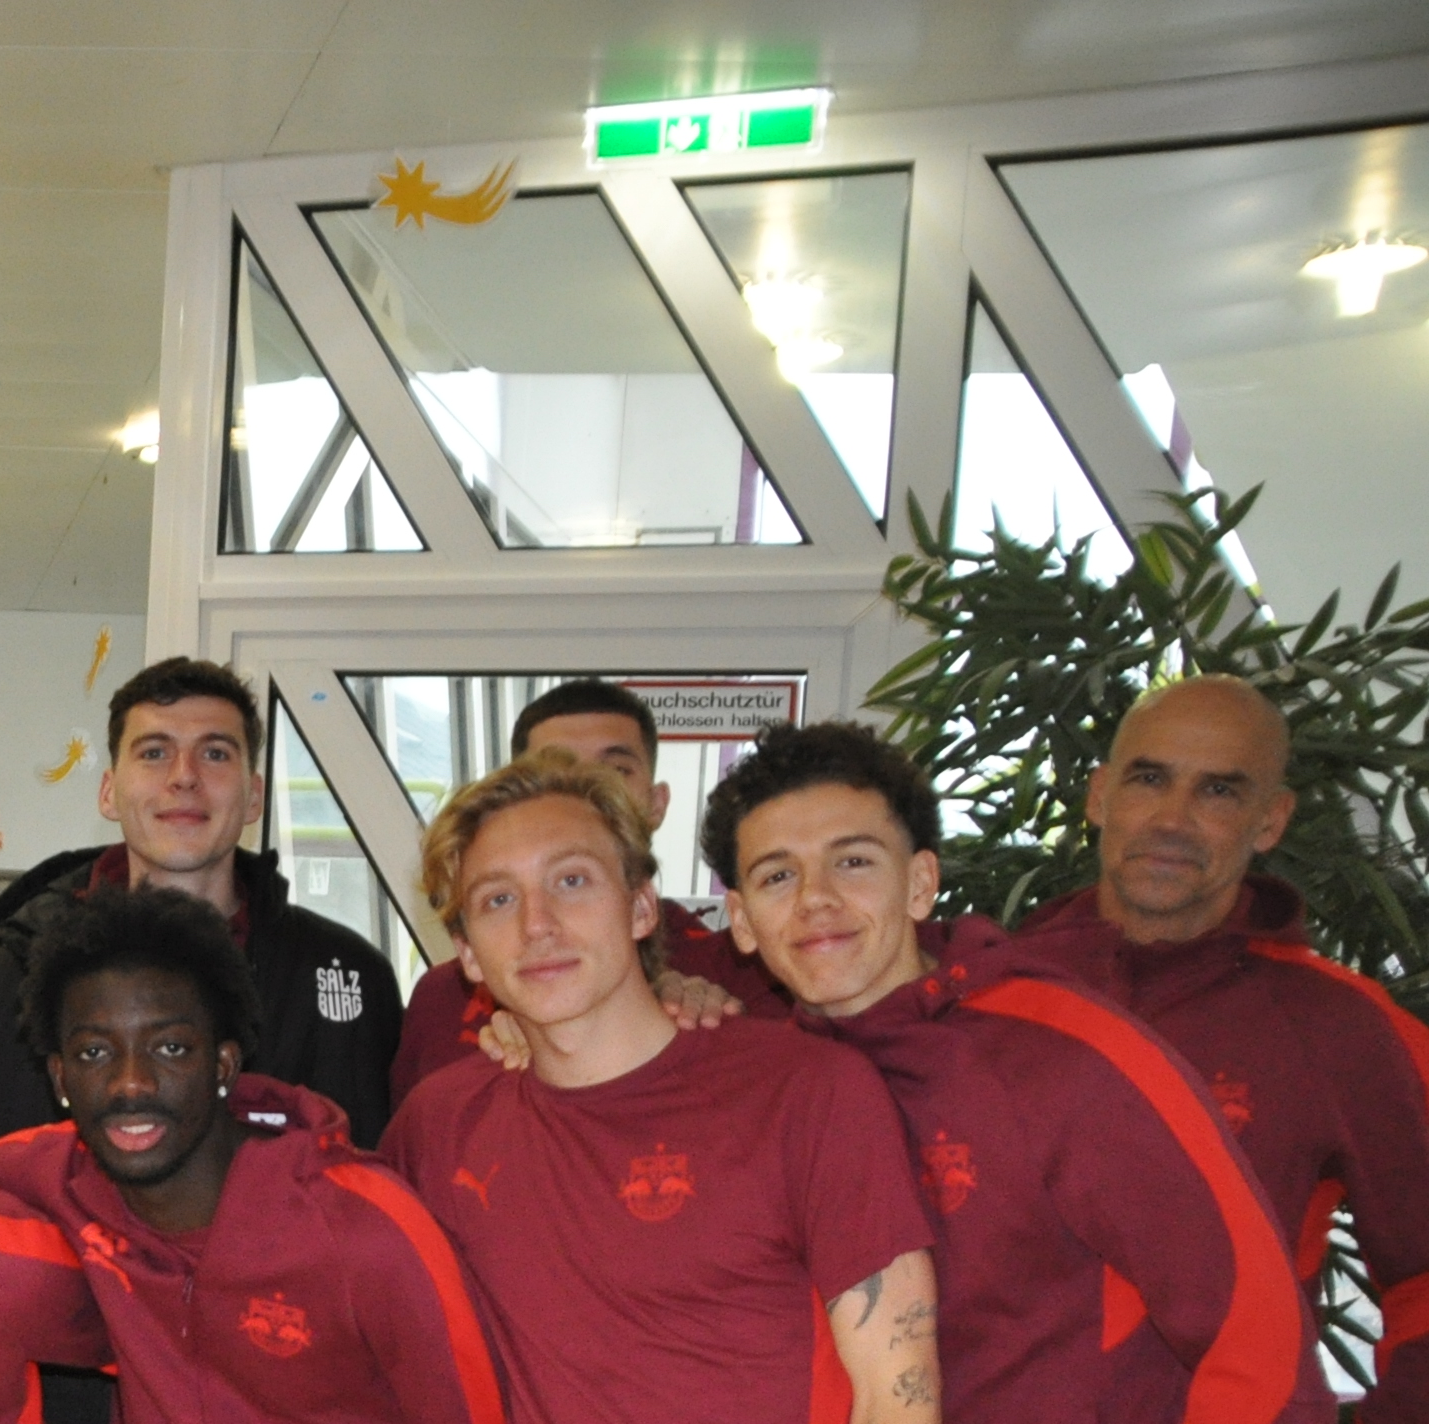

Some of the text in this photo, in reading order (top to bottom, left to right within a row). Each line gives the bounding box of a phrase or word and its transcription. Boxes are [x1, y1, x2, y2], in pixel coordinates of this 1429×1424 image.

[640, 691, 784, 708] auchschutztür
[655, 713, 724, 727] chlossen
[316, 967, 362, 994] SALZ
[317, 992, 363, 1022] BURG
